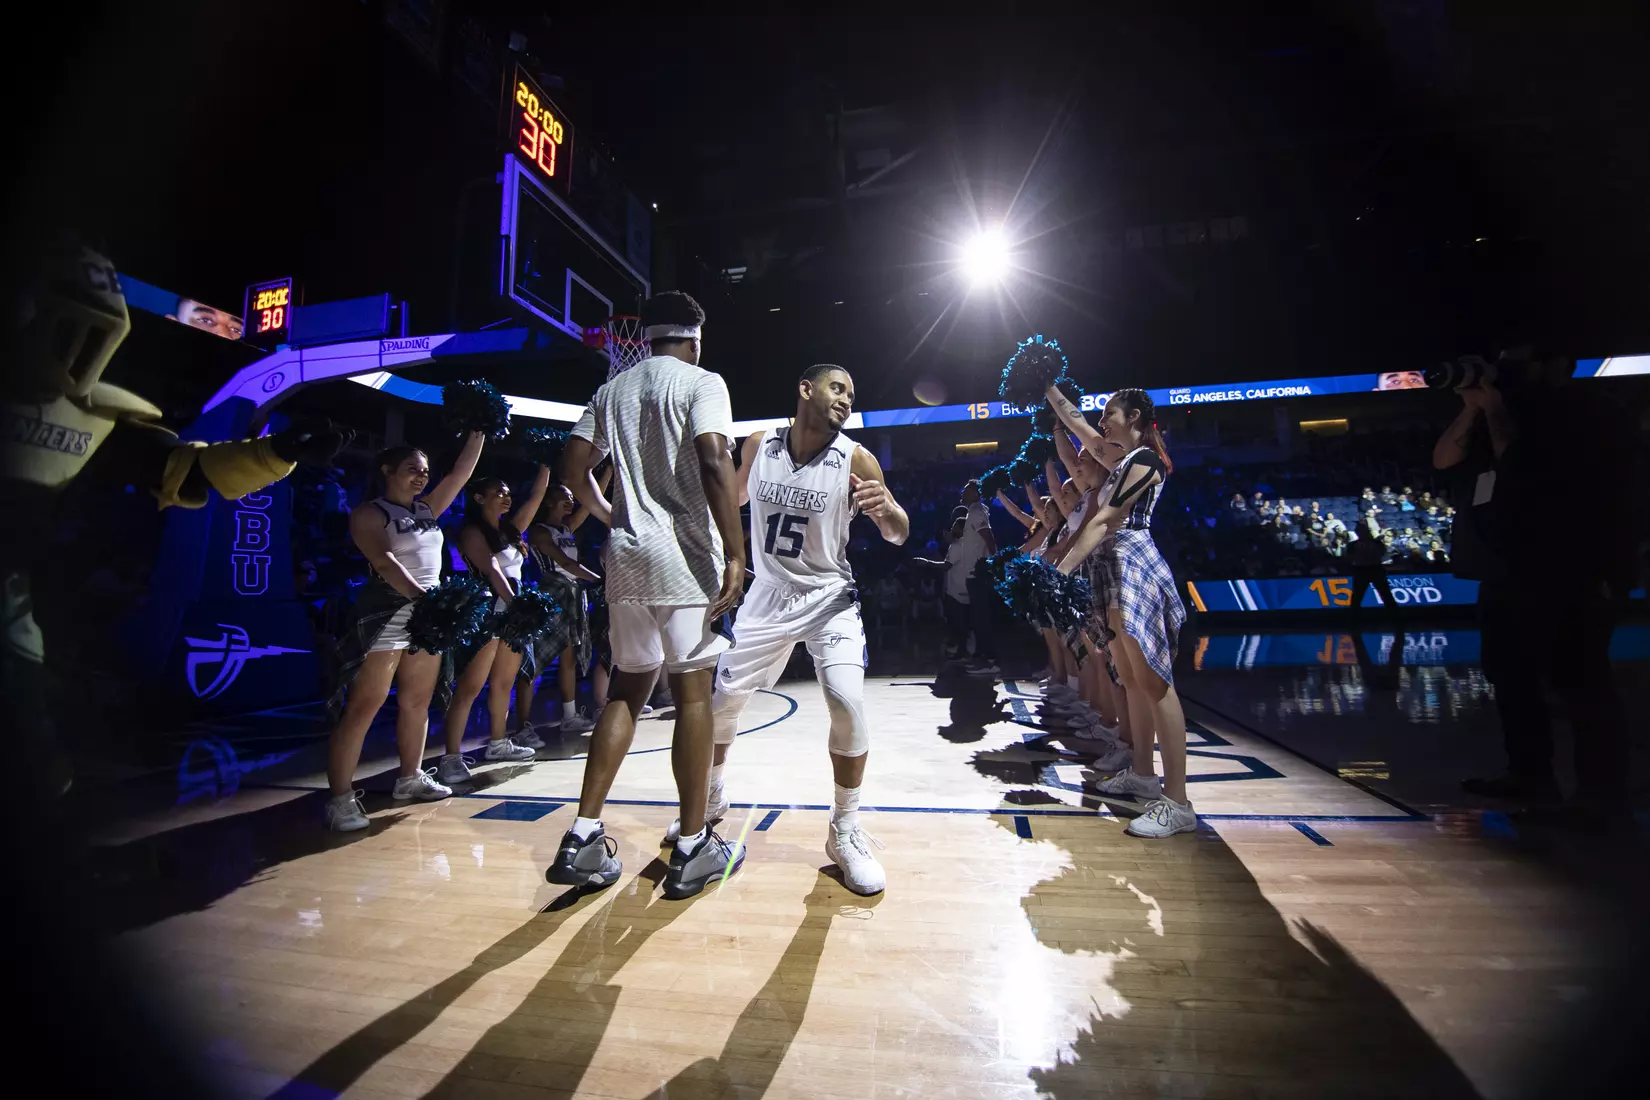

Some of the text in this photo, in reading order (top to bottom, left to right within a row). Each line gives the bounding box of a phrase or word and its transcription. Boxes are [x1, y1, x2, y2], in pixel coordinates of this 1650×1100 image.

[516, 81, 563, 145] 20:00
[519, 112, 556, 177] 30
[261, 307, 283, 331] 30
[380, 337, 430, 353] SPALDING
[1170, 386, 1311, 404] LOS ANGELES, CALIFORNIA
[967, 402, 990, 420] 15
[11, 417, 93, 457] NCERS
[823, 459, 840, 469] WAC
[757, 480, 829, 514] LANCERS
[764, 512, 810, 559] 15
[1309, 578, 1353, 606] 15
[1370, 578, 1434, 589] ANDON
